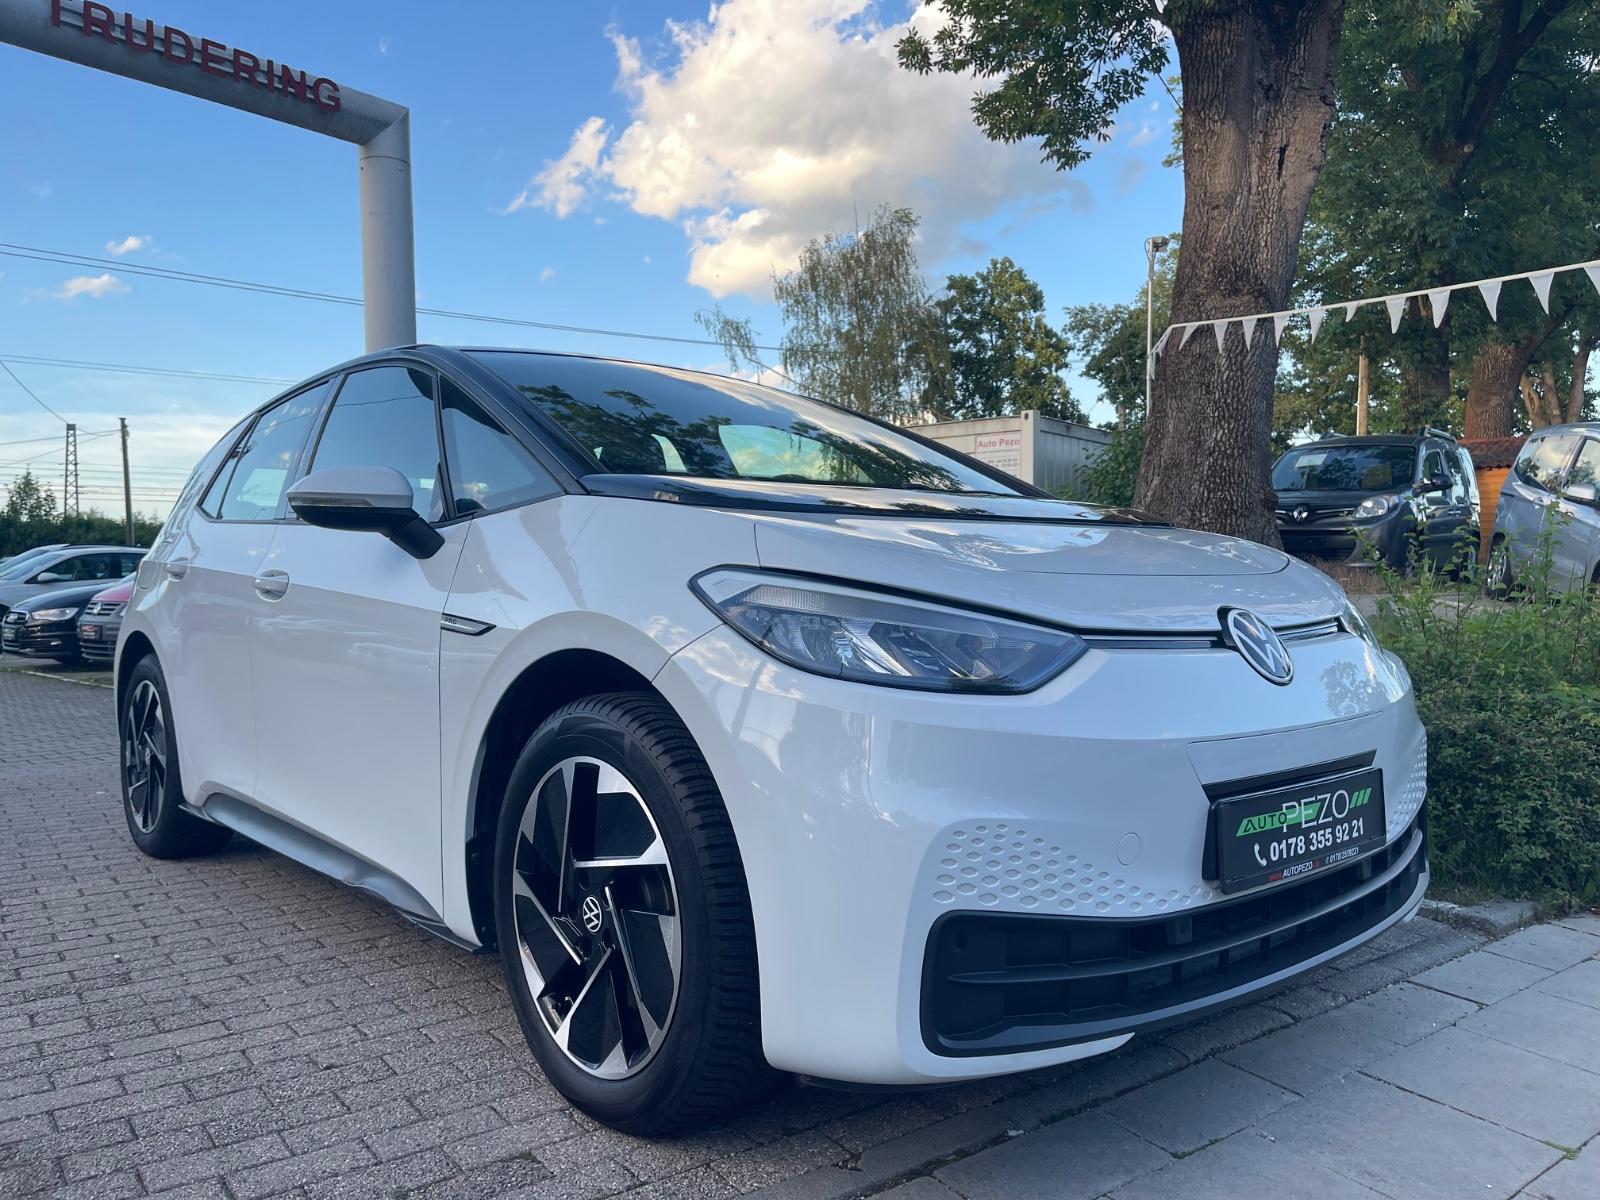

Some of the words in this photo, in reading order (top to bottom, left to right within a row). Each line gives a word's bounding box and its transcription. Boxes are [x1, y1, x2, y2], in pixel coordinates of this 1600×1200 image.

[977, 440, 997, 449] Auto
[999, 438, 1020, 447] Pezo
[1243, 811, 1288, 832] AUTO
[1282, 789, 1349, 833] PEZO
[1270, 835, 1306, 862] 0178
[1309, 827, 1333, 851] 355
[1335, 822, 1350, 843] 92
[1352, 817, 1364, 838] 21
